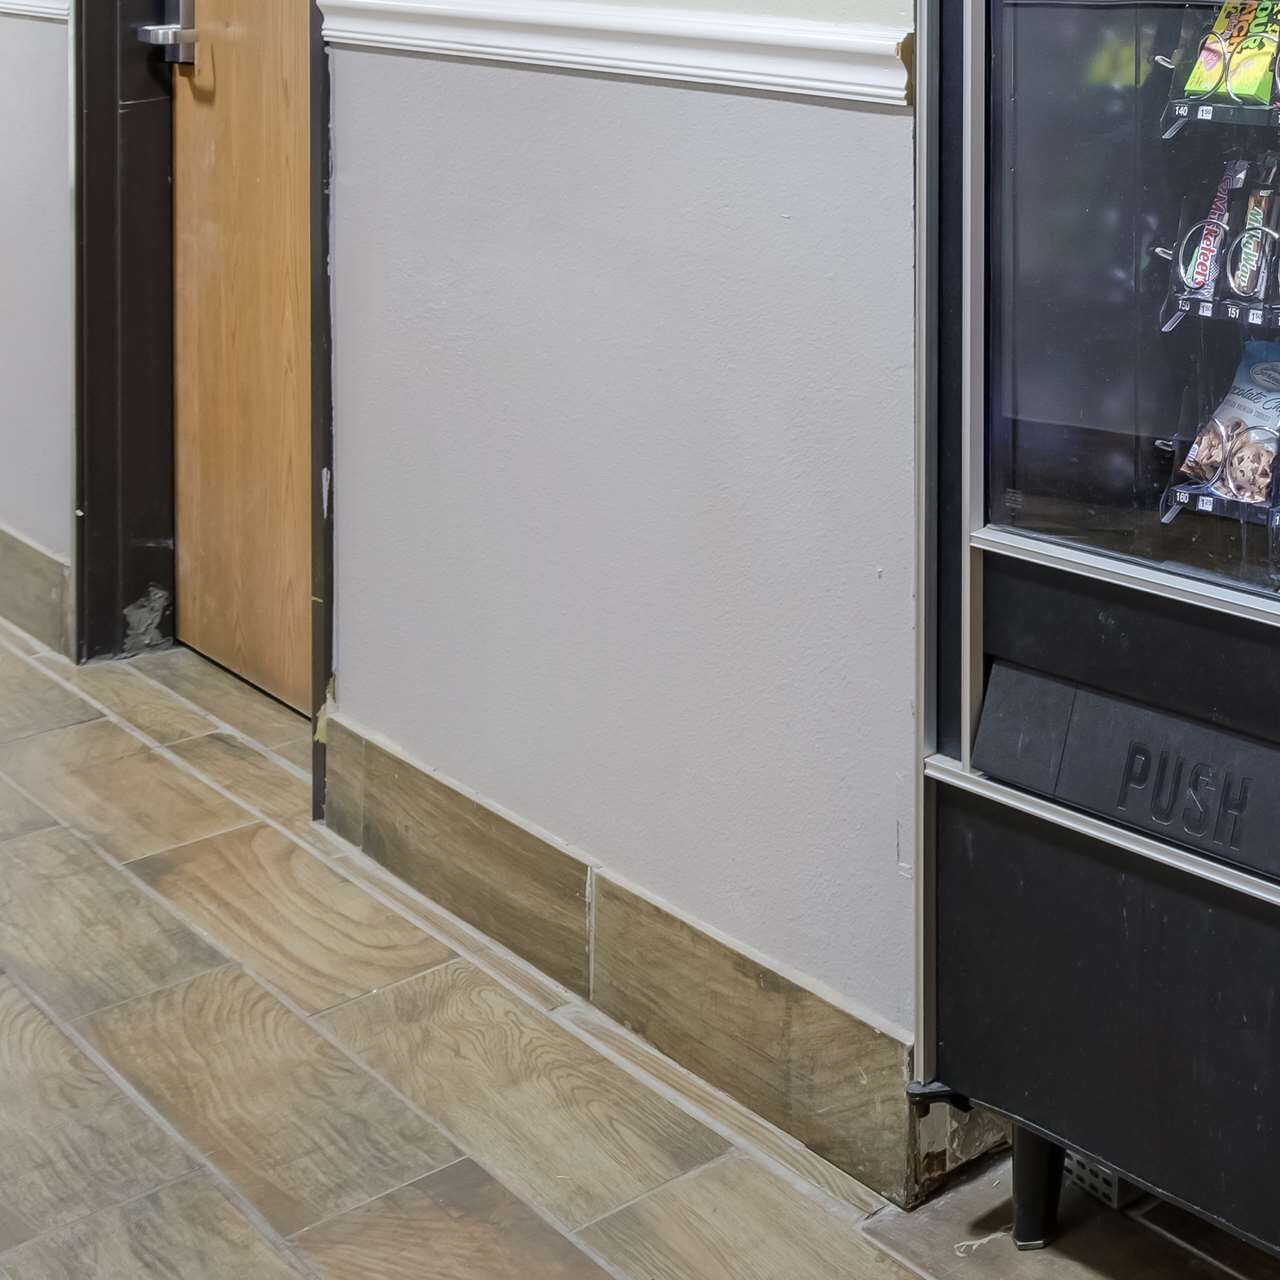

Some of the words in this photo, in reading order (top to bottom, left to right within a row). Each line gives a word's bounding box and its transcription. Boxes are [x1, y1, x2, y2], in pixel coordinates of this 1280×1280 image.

[1175, 106, 1188, 116] 140
[1227, 308, 1240, 318] 151
[1176, 492, 1190, 503] 160
[1116, 738, 1252, 853] PUSH
